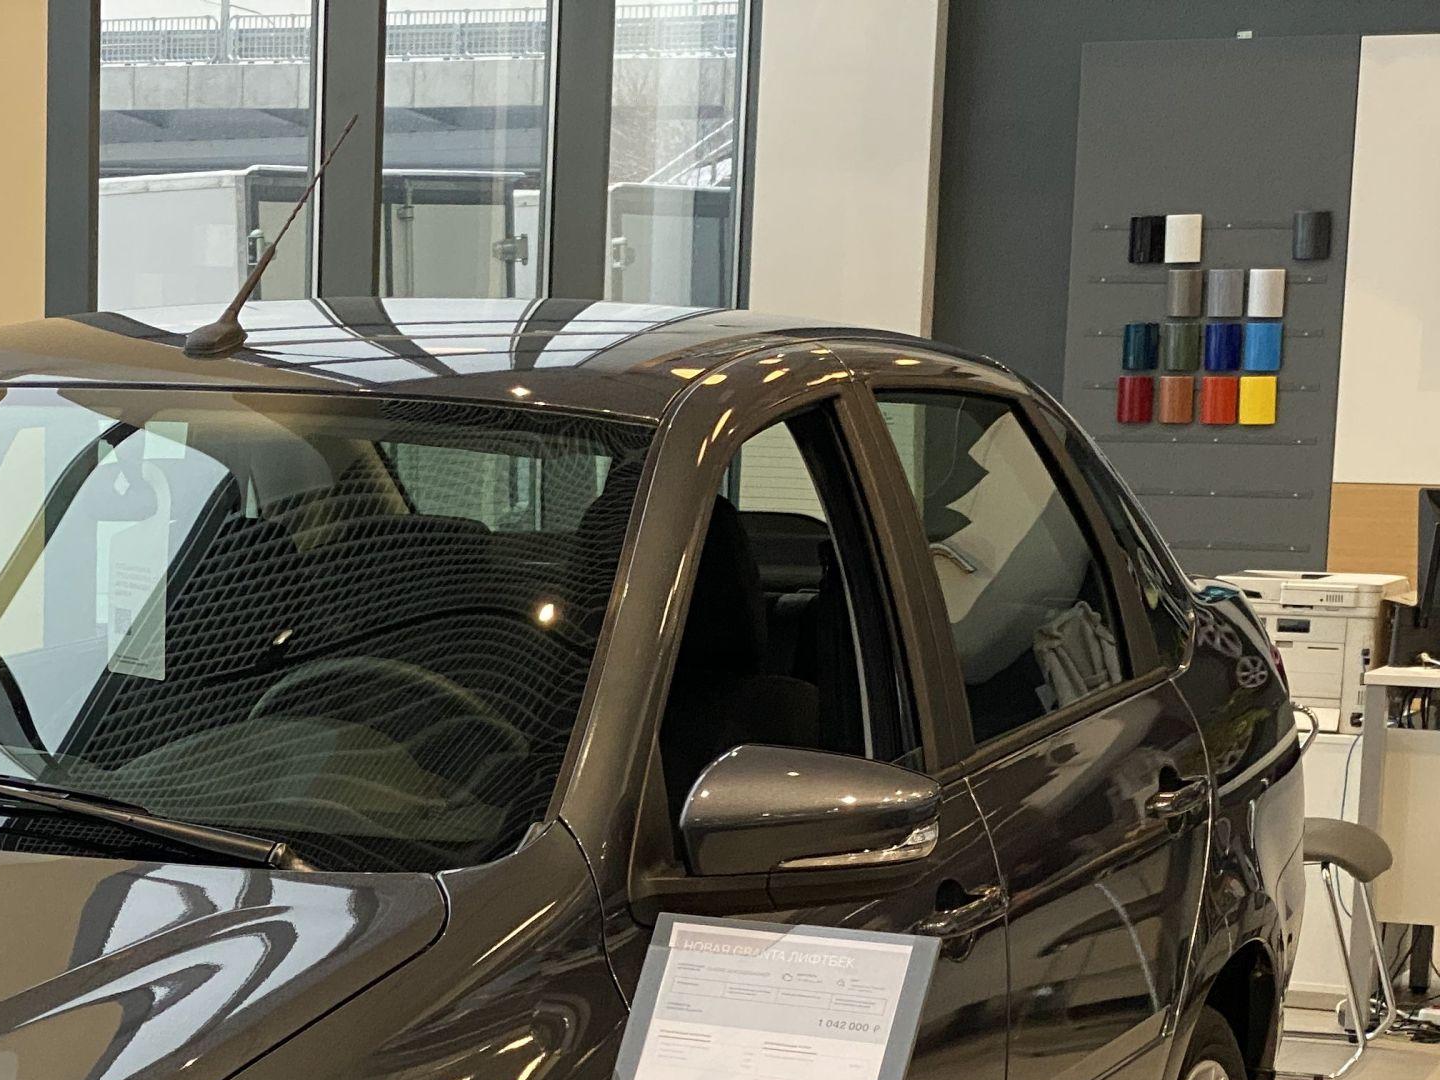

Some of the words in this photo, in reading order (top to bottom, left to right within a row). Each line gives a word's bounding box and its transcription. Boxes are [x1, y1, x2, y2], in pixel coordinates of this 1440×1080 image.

[683, 939, 730, 955] НОВАЯ
[732, 944, 786, 961] GRANTA
[787, 950, 856, 969] ЛИФТБЕК
[826, 1019, 847, 1030] 042
[849, 1022, 870, 1032] 000
